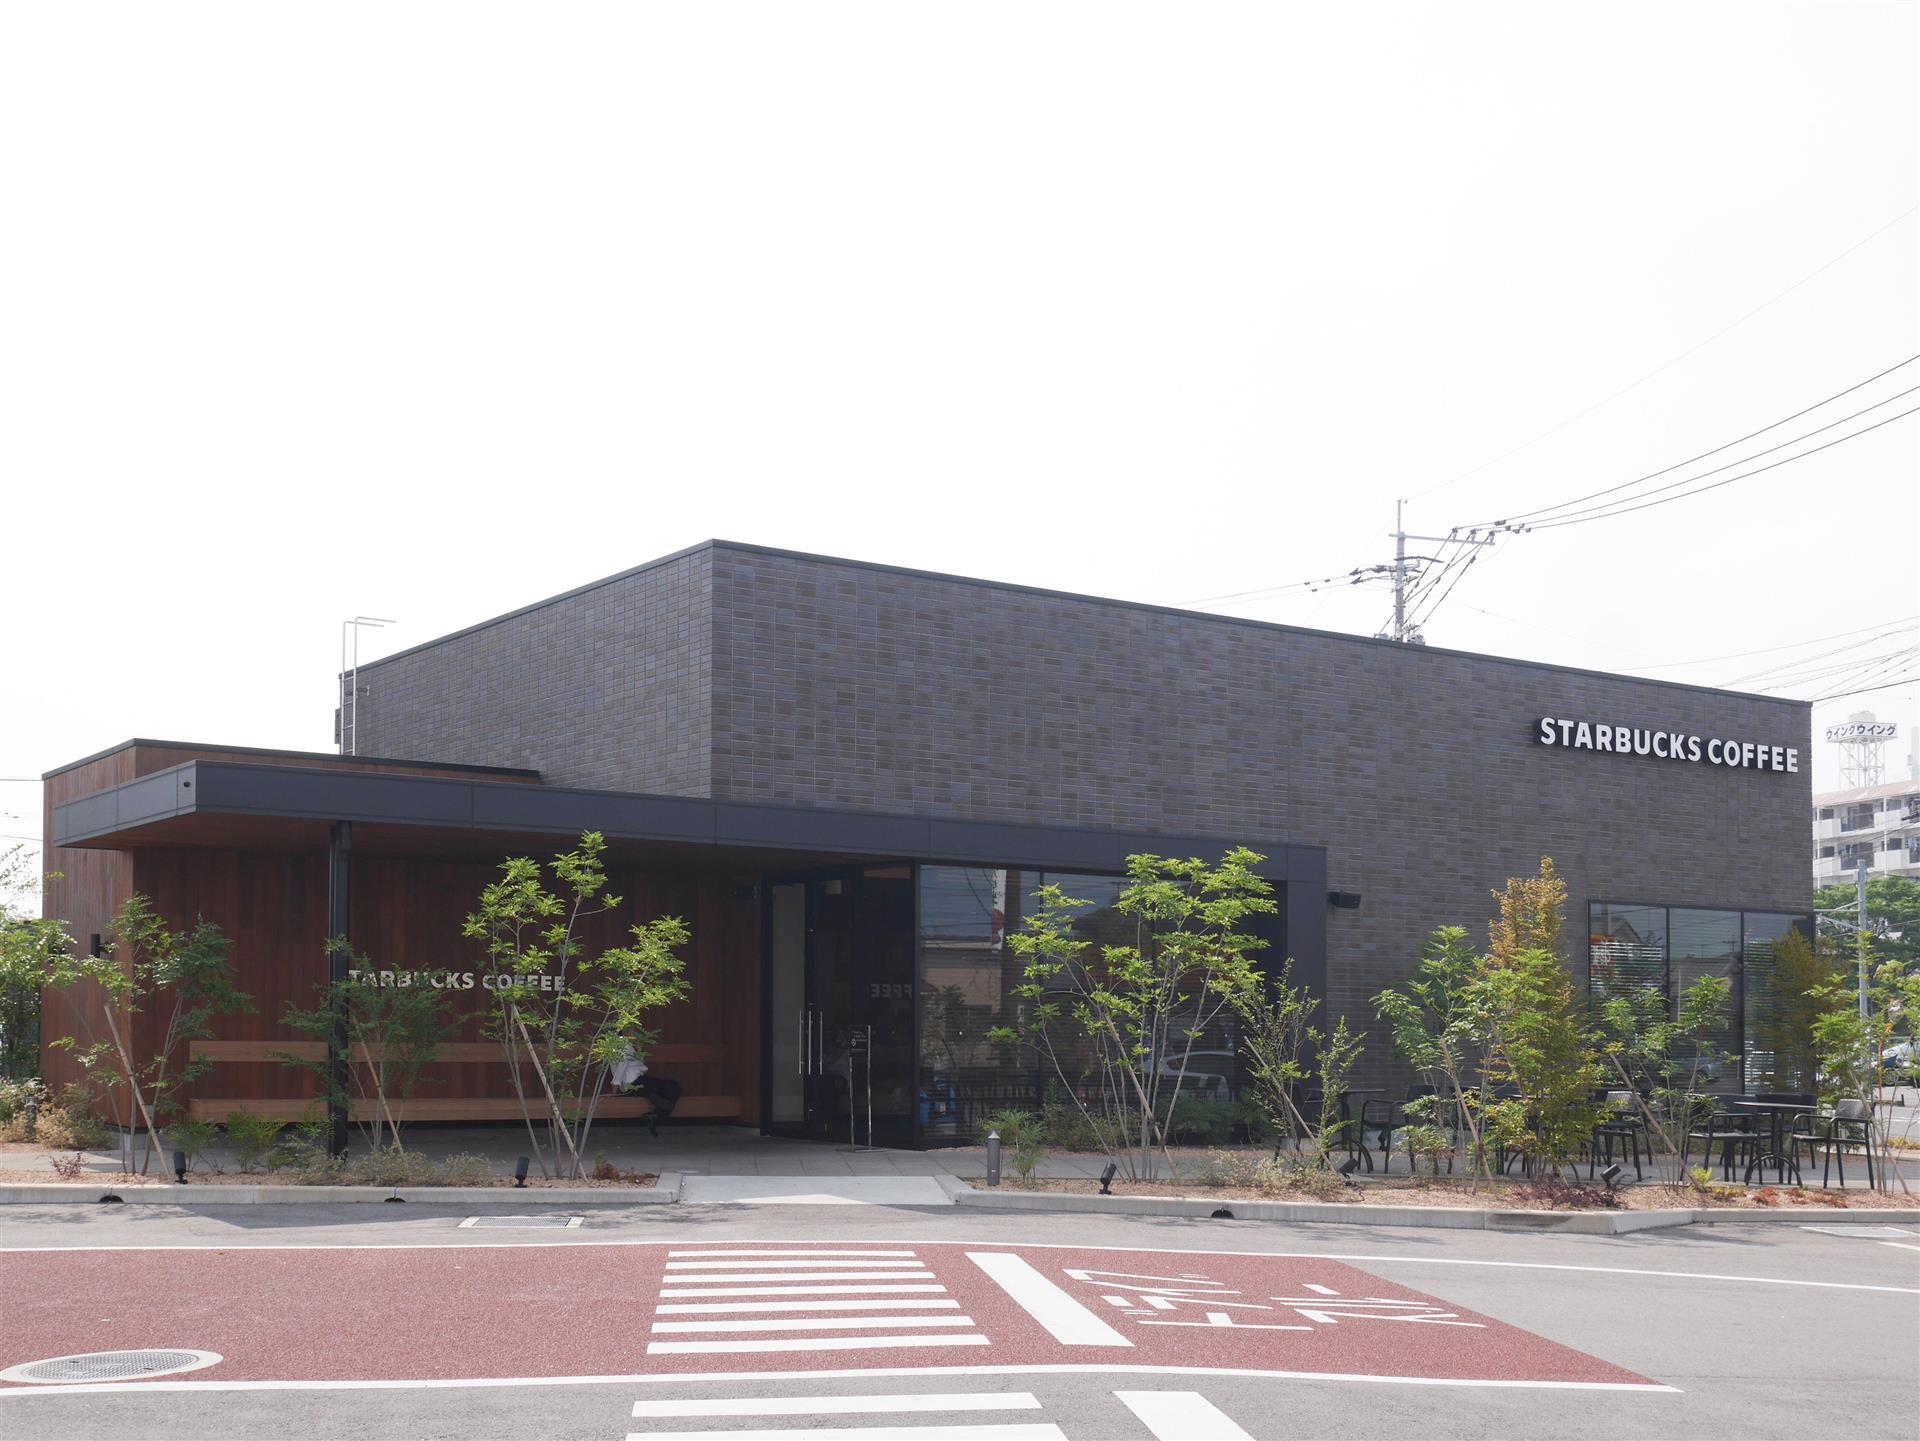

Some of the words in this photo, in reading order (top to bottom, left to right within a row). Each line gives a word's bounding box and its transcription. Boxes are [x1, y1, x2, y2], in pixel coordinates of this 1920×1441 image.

[1826, 724, 1855, 740] ウイング
[1856, 724, 1896, 736] ウイング
[1540, 717, 1701, 762] STARBUCKS
[1707, 738, 1799, 773] COFFEE
[348, 969, 474, 990] TARBCKS
[1269, 1283, 1487, 1328] スルー
